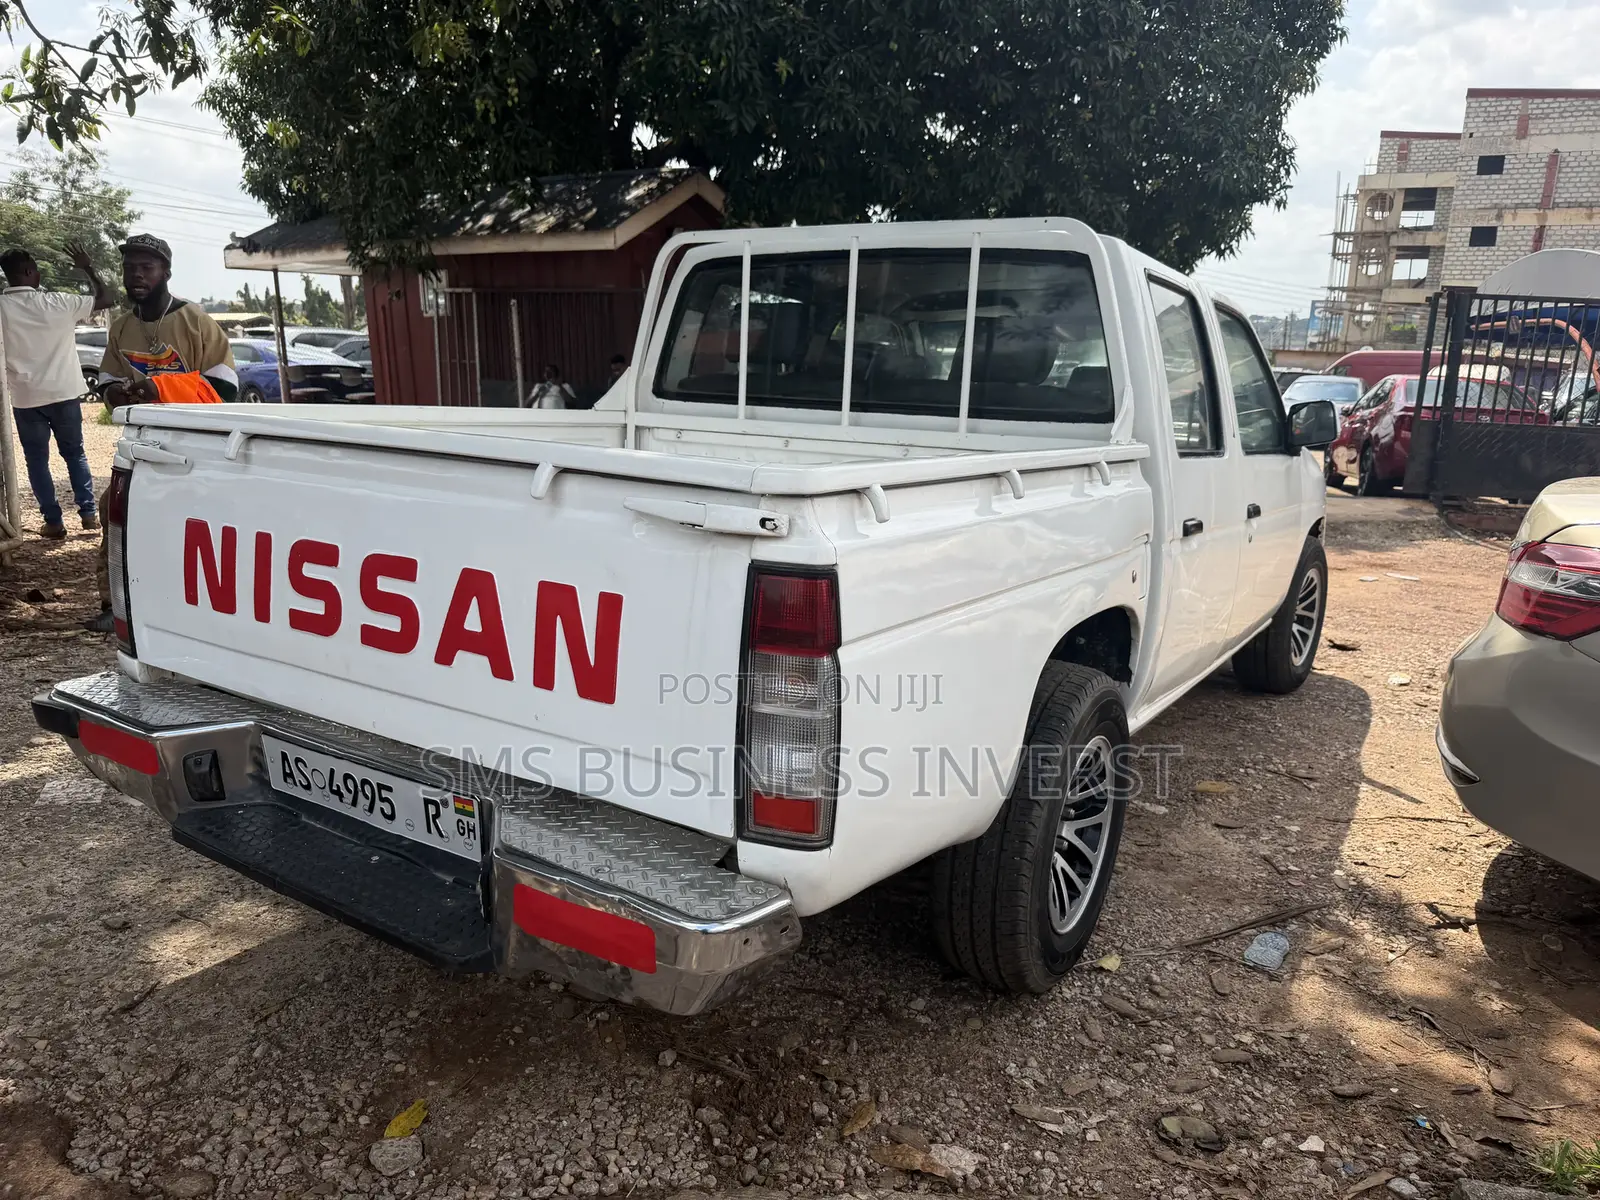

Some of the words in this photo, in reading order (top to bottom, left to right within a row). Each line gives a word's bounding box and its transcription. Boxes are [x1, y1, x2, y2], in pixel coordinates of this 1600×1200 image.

[184, 517, 624, 704] NISSAN
[281, 750, 312, 790] AS
[329, 767, 396, 821] 4995
[423, 797, 444, 838] R
[456, 818, 476, 840] GH
